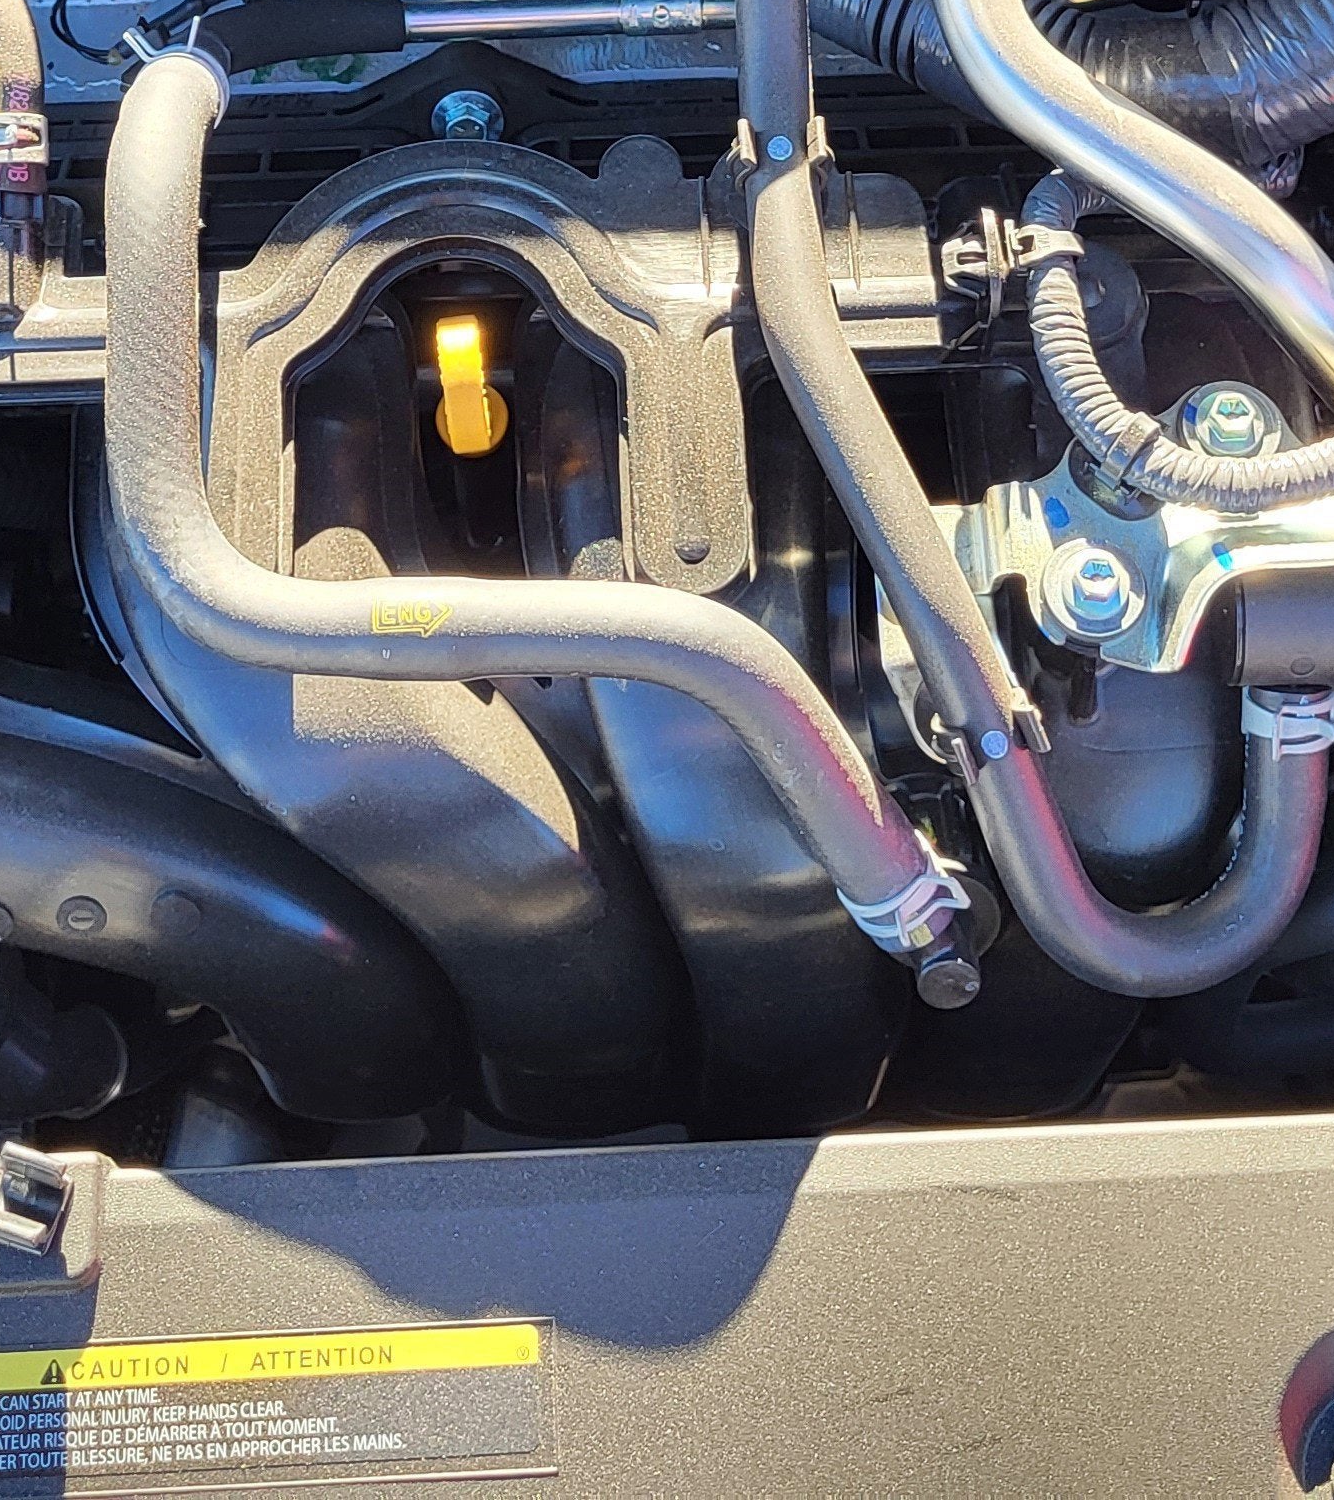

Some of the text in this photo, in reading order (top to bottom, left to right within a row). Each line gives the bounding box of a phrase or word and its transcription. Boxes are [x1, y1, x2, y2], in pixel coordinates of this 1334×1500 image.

[381, 601, 432, 624] ENG
[71, 1356, 190, 1380] CAUTION
[250, 1345, 393, 1371] ATTENTION
[0, 1395, 29, 1411] CAN
[32, 1392, 72, 1409] START
[74, 1391, 93, 1407] AT
[95, 1390, 125, 1406] ANY
[125, 1387, 161, 1405] TIME.
[28, 1411, 99, 1430] PERSONAL
[102, 1407, 150, 1427] INJURY,
[153, 1406, 185, 1423] KEEP
[188, 1403, 238, 1421] HANDS
[240, 1401, 287, 1418] CLEAR.
[46, 1431, 98, 1449] RISQUE
[101, 1429, 122, 1445] DE
[125, 1423, 207, 1443] DÉMARRER
[208, 1419, 222, 1438] À
[223, 1419, 266, 1437] TOUT
[267, 1416, 339, 1435] MOMENT.
[18, 1452, 68, 1470] TOUTE
[72, 1449, 149, 1467] BLESSURE,
[152, 1447, 172, 1462] NE
[175, 1445, 204, 1461] PAS
[208, 1442, 228, 1459] EN
[230, 1436, 321, 1457] APPROCHER
[324, 1435, 350, 1451] LES
[353, 1432, 407, 1451] MAINS.
